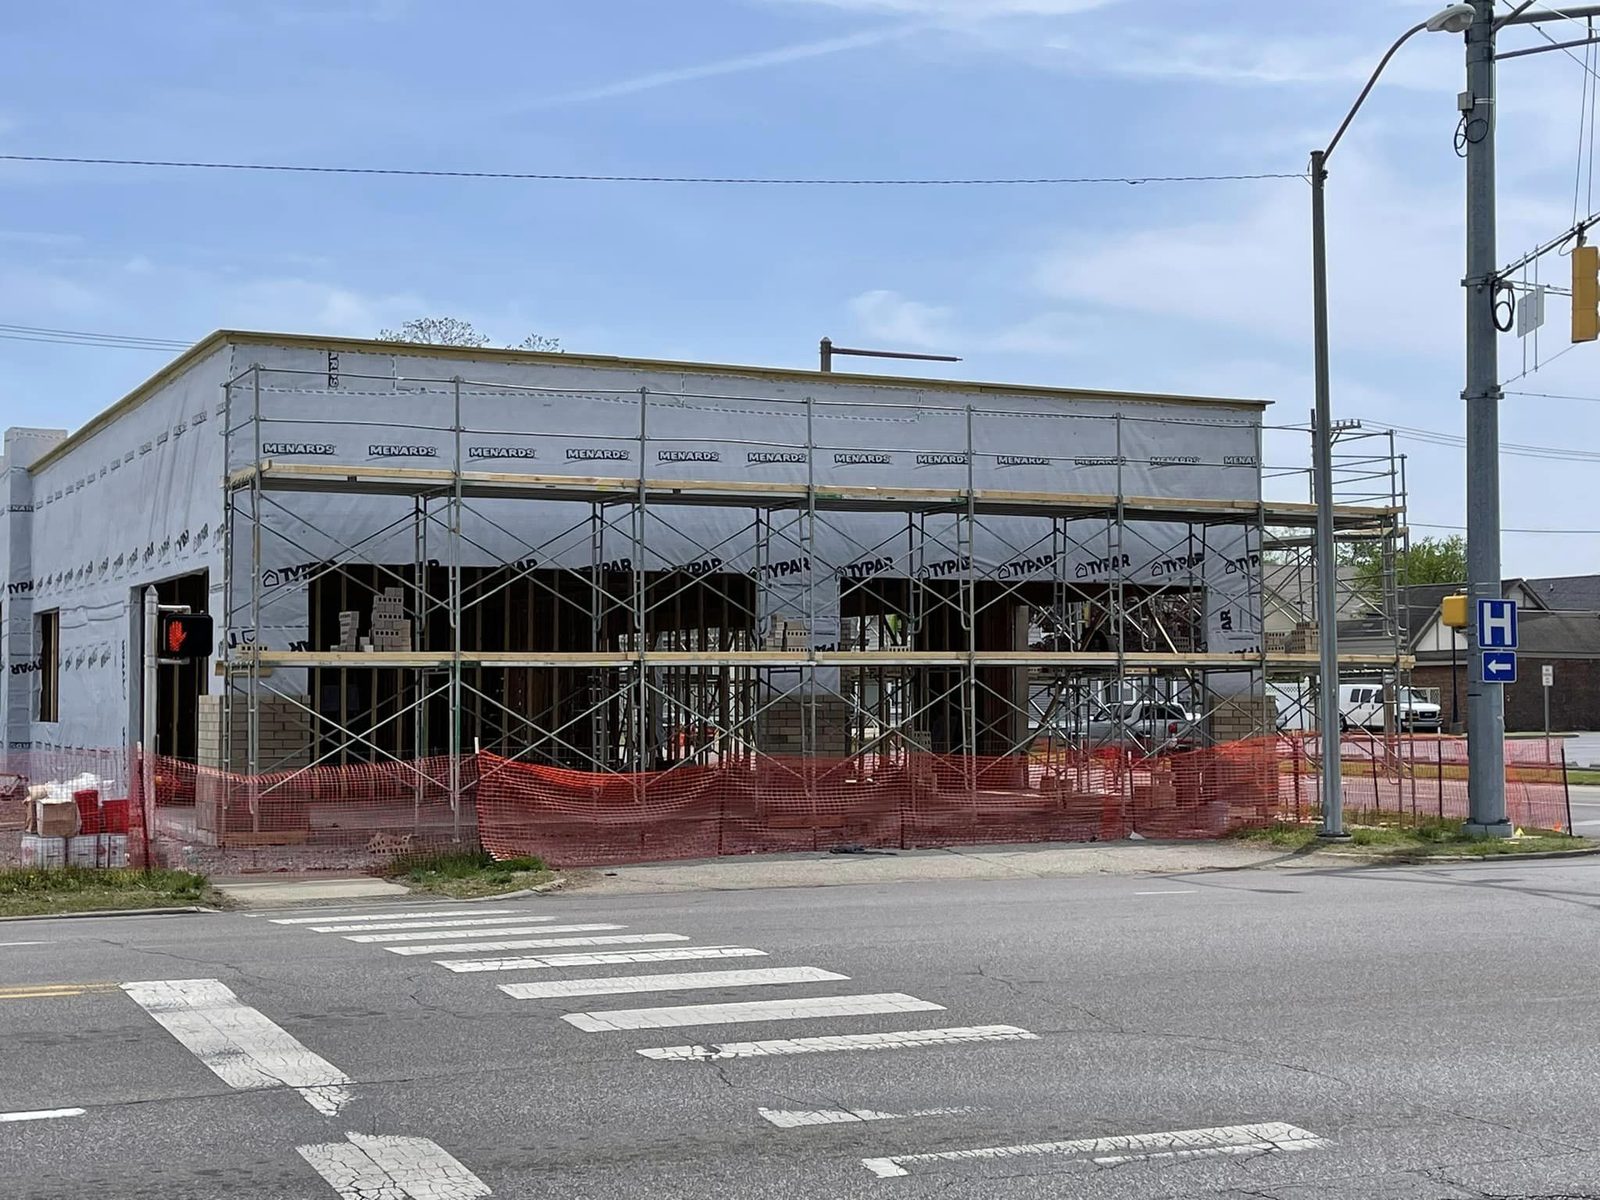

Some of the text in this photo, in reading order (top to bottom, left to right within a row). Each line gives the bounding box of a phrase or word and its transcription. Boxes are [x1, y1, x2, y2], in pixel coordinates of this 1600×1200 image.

[263, 443, 336, 455] MENARDS
[369, 445, 437, 457] MENARDS
[469, 447, 536, 458] MENARDS
[566, 449, 630, 460] MENARDS
[659, 451, 719, 462] MENARDS
[748, 453, 807, 463] MENARDS
[835, 454, 890, 464] MENARDS
[997, 456, 1049, 466] MENARDS
[759, 557, 811, 580] TYPAR
[848, 557, 893, 577] TYPAR
[1010, 555, 1055, 576] TYPAR
[1087, 554, 1130, 575] TYPAR
[1484, 602, 1512, 646] H
